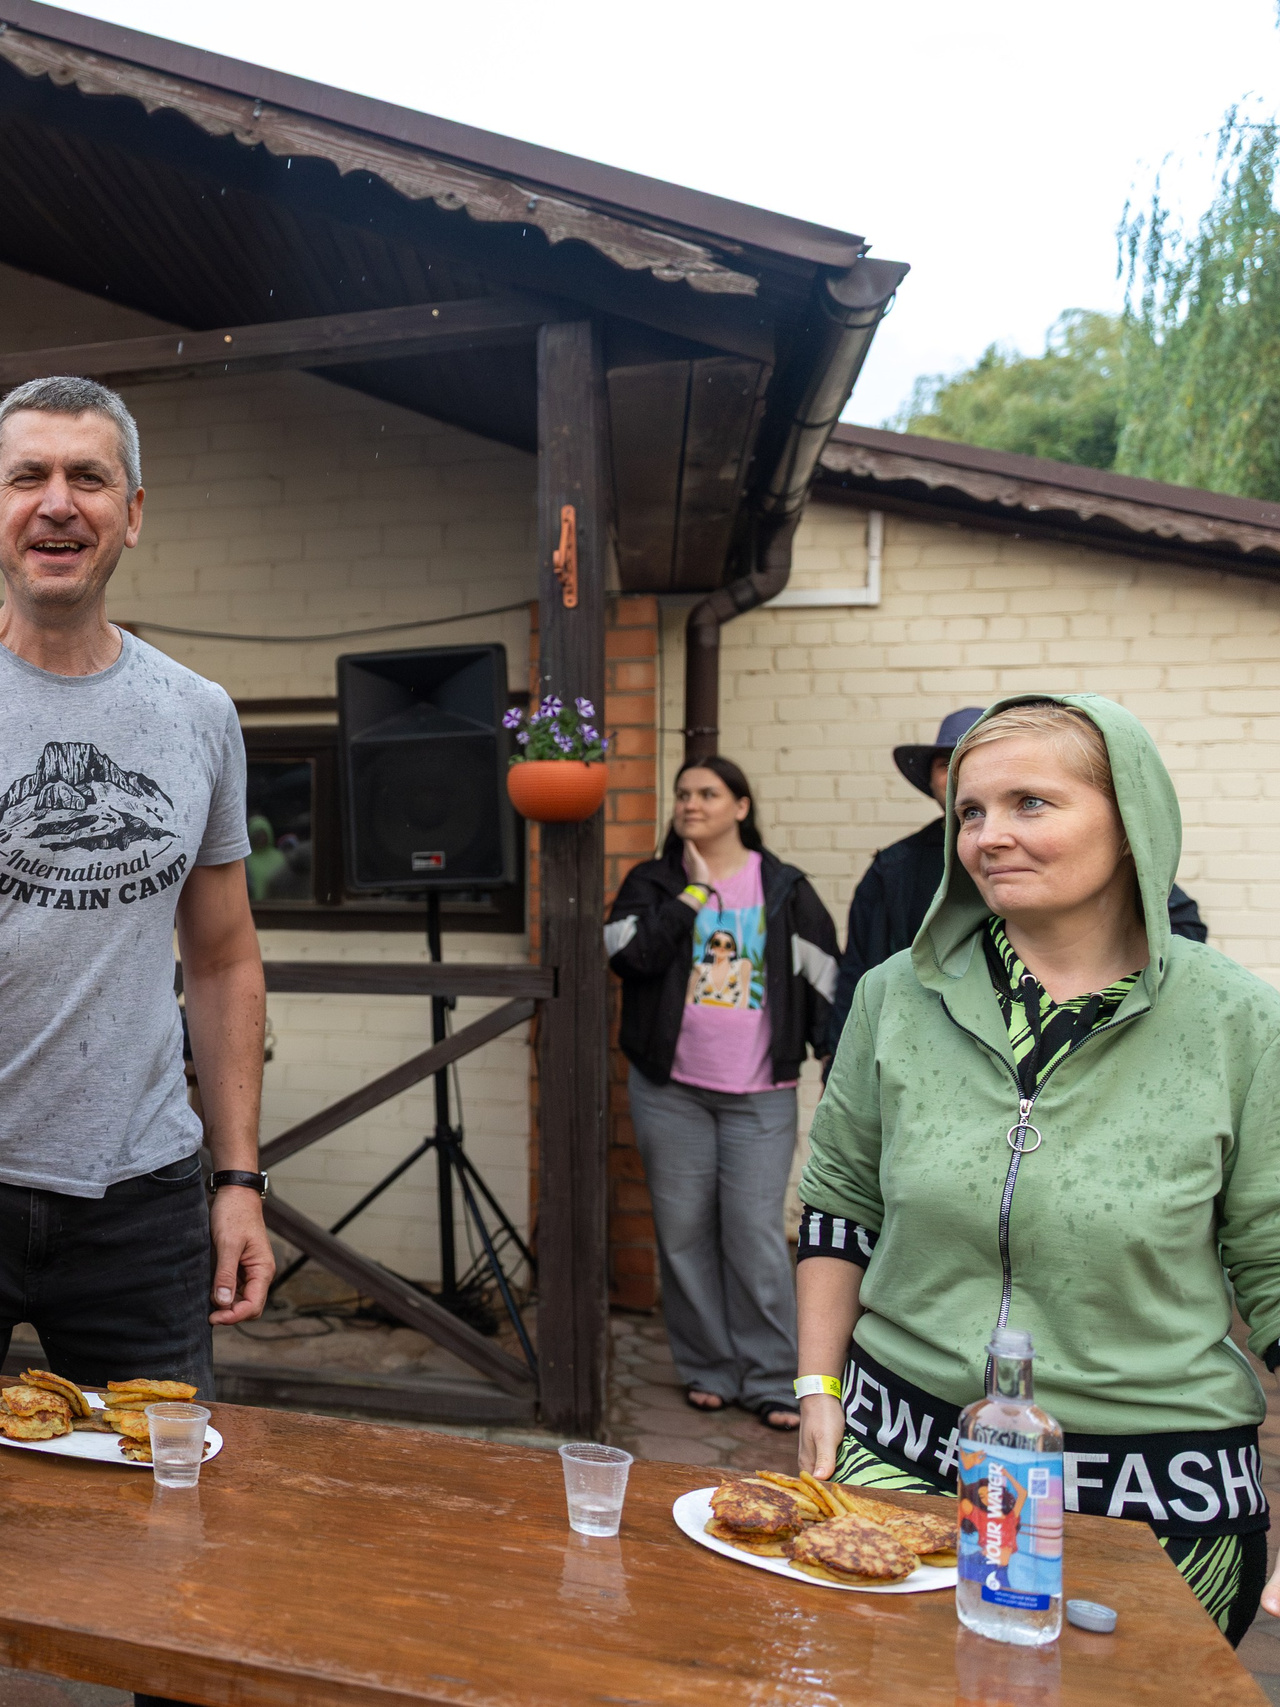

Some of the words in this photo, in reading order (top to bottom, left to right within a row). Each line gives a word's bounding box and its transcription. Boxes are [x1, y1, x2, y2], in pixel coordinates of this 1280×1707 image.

[6, 848, 151, 883] International
[118, 853, 188, 905] CAMP
[987, 1461, 1004, 1519] WATER
[1063, 1445, 1265, 1522] FASHI
[986, 1521, 1003, 1566] YOUR
